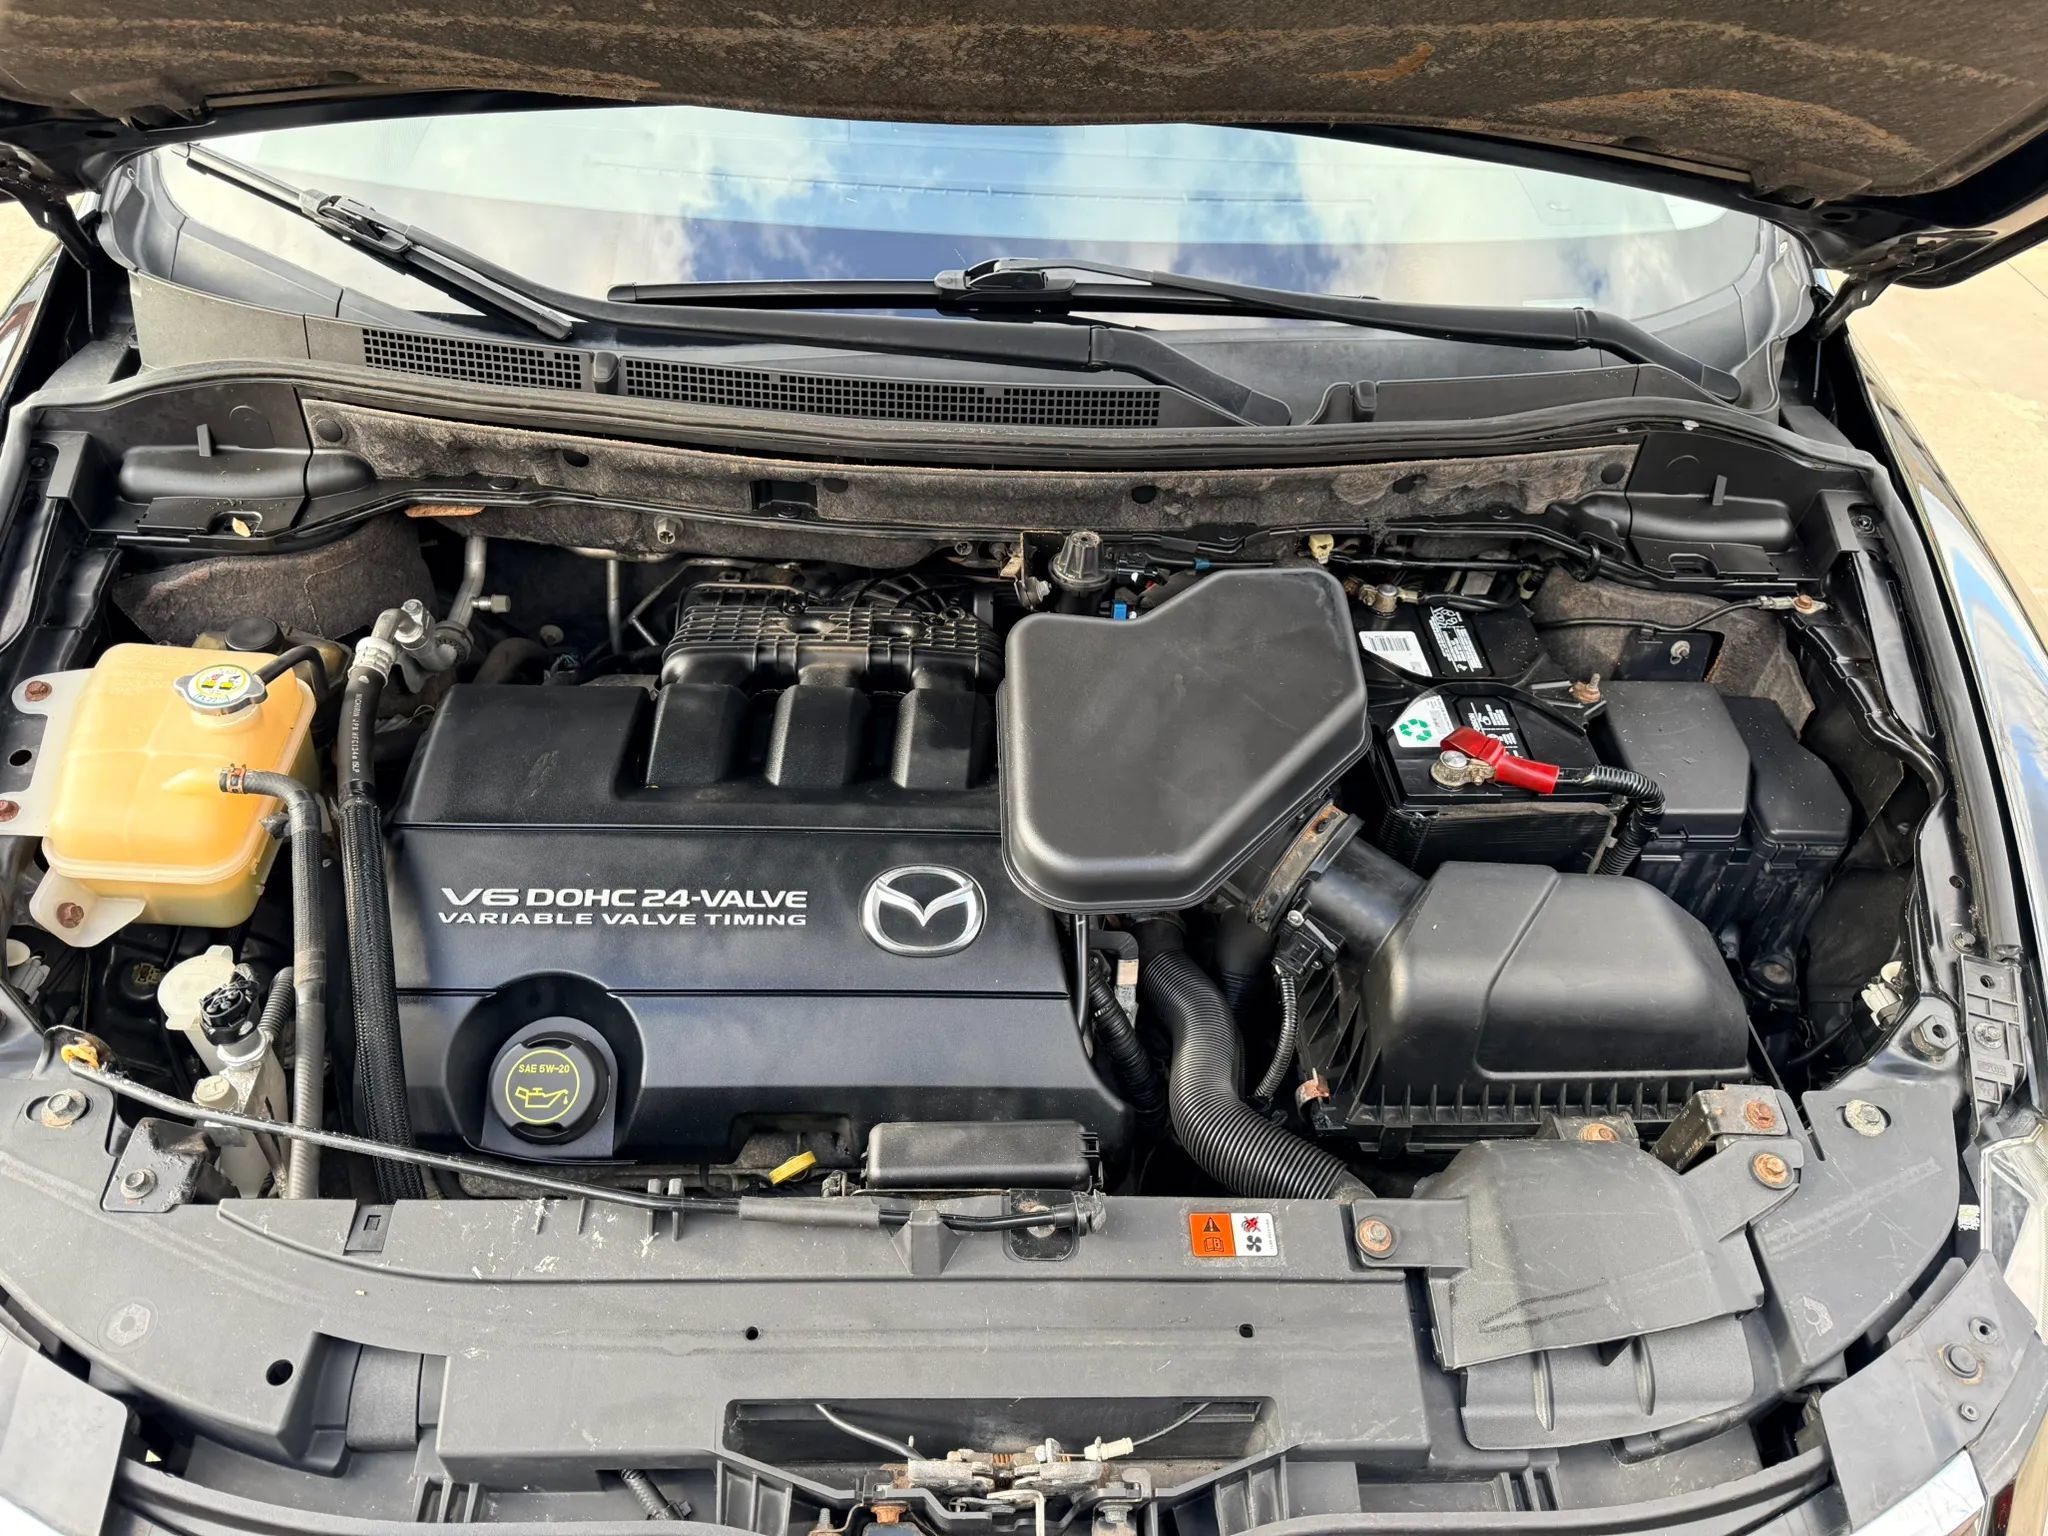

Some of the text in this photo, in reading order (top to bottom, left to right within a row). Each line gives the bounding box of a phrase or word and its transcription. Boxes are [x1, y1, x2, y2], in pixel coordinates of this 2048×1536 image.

[440, 887, 809, 909] V6 DOHC 24-VALVE
[438, 911, 807, 926] VARIABLE VALVE TIMING
[518, 1063, 570, 1074] SAE 5W-20
